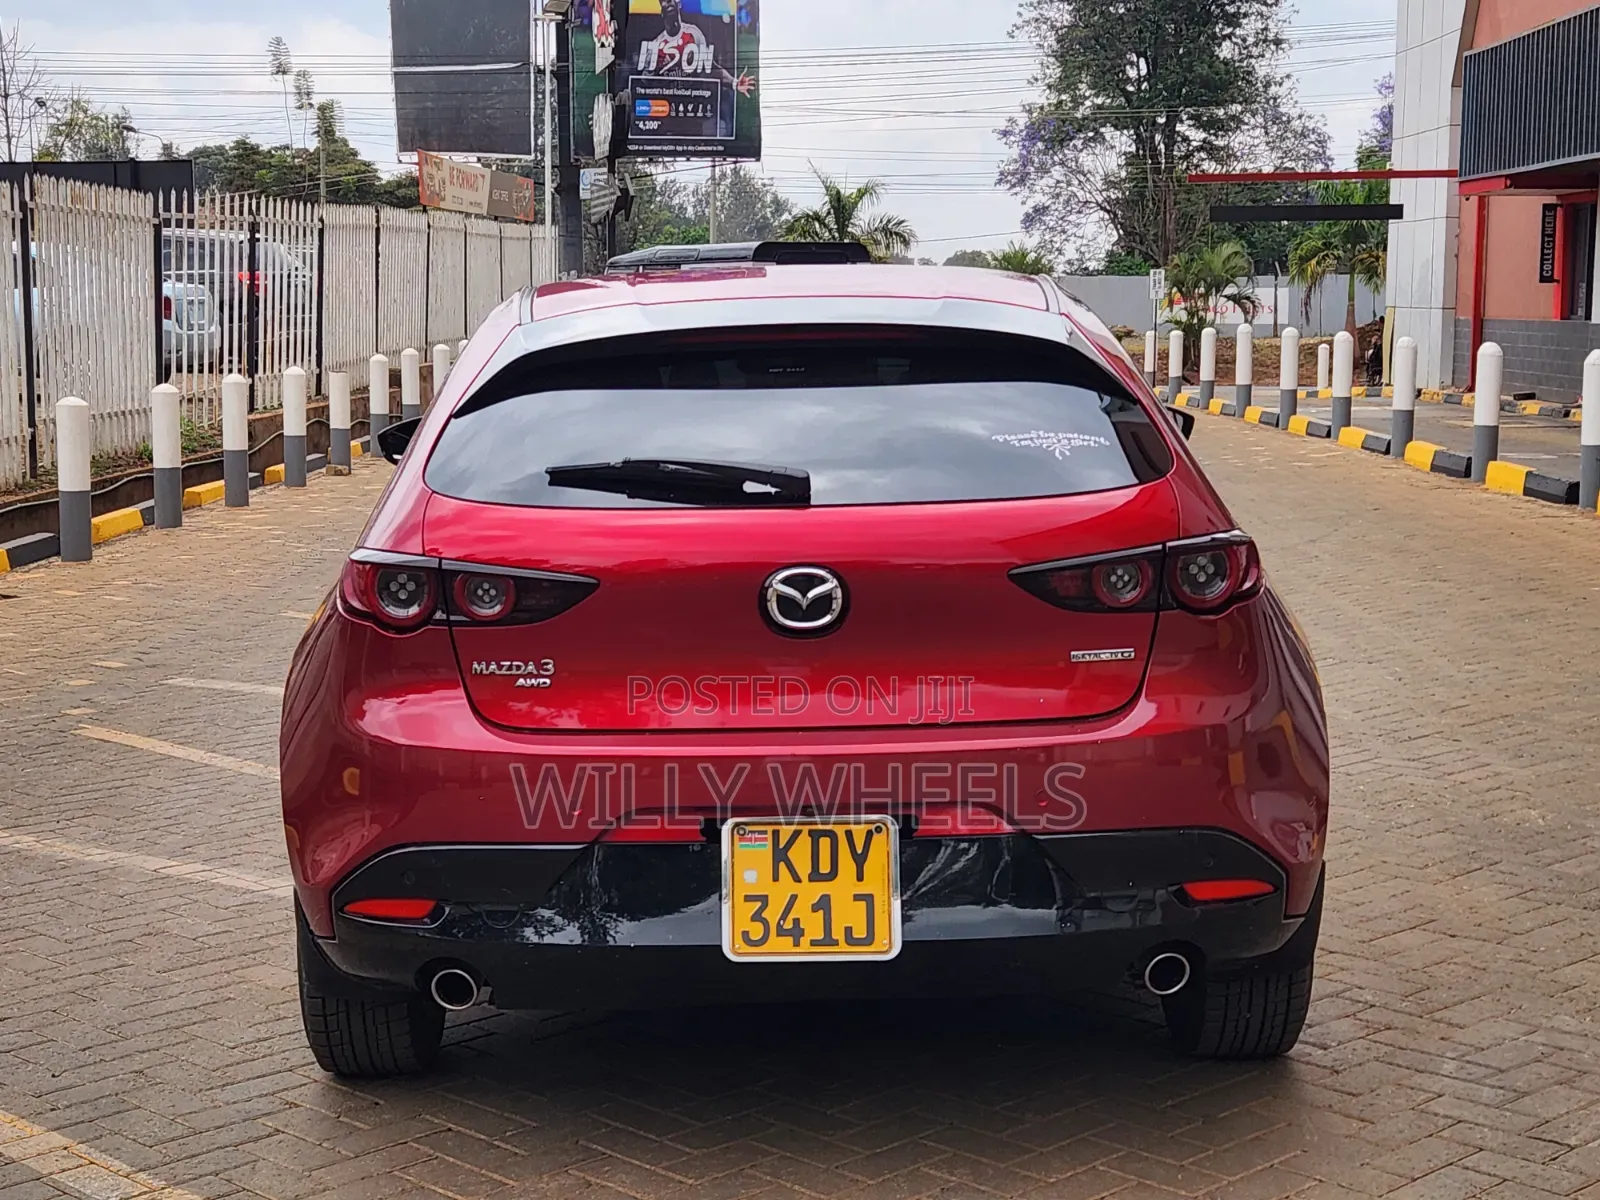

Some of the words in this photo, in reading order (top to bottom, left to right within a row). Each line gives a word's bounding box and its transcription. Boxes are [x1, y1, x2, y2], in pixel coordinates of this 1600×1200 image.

[637, 40, 680, 74] IT'S
[682, 43, 714, 73] ON
[645, 87, 662, 95] world's
[674, 88, 692, 96] football
[692, 89, 712, 98] package
[1545, 210, 1555, 234] HERE
[1543, 236, 1554, 277] COLLECT
[514, 678, 551, 688] AWD
[771, 829, 874, 883] KDY
[741, 893, 875, 947] 341J
